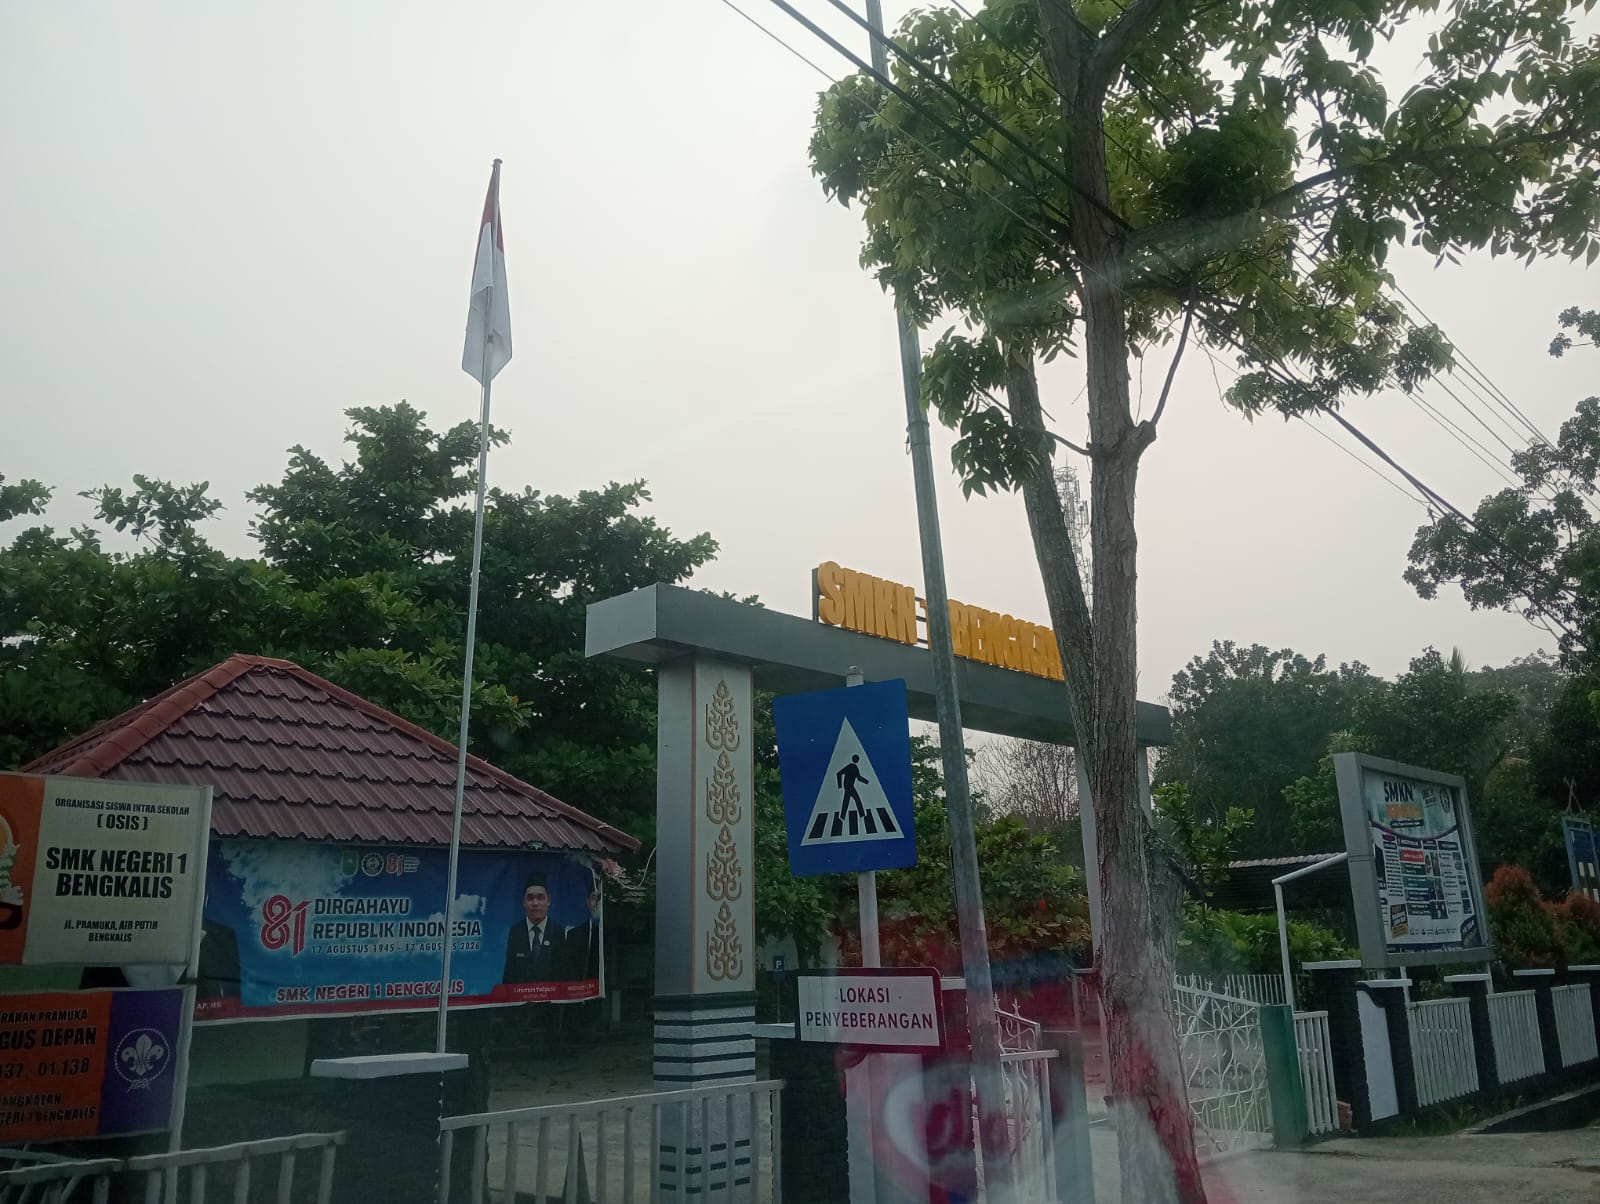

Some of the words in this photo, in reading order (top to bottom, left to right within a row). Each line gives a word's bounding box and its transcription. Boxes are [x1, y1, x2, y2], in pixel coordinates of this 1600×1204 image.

[817, 560, 918, 645] SMKN
[1383, 781, 1414, 802] SMKN
[55, 797, 104, 810] ORGANISASI
[105, 801, 131, 812] SISWA
[132, 802, 156, 814] INTRA
[156, 805, 190, 816] SEKOLAH
[46, 846, 97, 871] SMK
[100, 849, 173, 874] NEGERI
[177, 853, 188, 874] 1
[55, 872, 173, 899] BENGKALIS
[314, 898, 410, 915] DIRGAHAYU
[64, 919, 75, 930] JL.
[76, 919, 118, 931] PRAMUKA,
[119, 920, 133, 930] AIR
[134, 920, 158, 930] PUTIH
[261, 894, 313, 958] 81
[313, 922, 394, 939] REPUBLIK
[88, 932, 133, 943] BENGKALIS
[312, 945, 322, 954] 17
[327, 944, 369, 954] AGUSTUS
[373, 944, 394, 953] 1945
[405, 943, 415, 952] 17
[419, 942, 457, 952] AGUSS
[775, 960, 782, 969] P
[277, 986, 310, 1001] SMK
[315, 984, 370, 1000] NEGERI
[375, 984, 381, 997] 1
[386, 979, 464, 997] BENGKAIS
[839, 987, 890, 1003] LOKASI
[0, 1011, 36, 1024] RAKAN
[38, 1008, 88, 1022] PRAMUKA
[806, 1011, 933, 1029] PENYEBERANGAN
[40, 1027, 97, 1048] DEPAN
[0, 1092, 62, 1107] ANGKALAN
